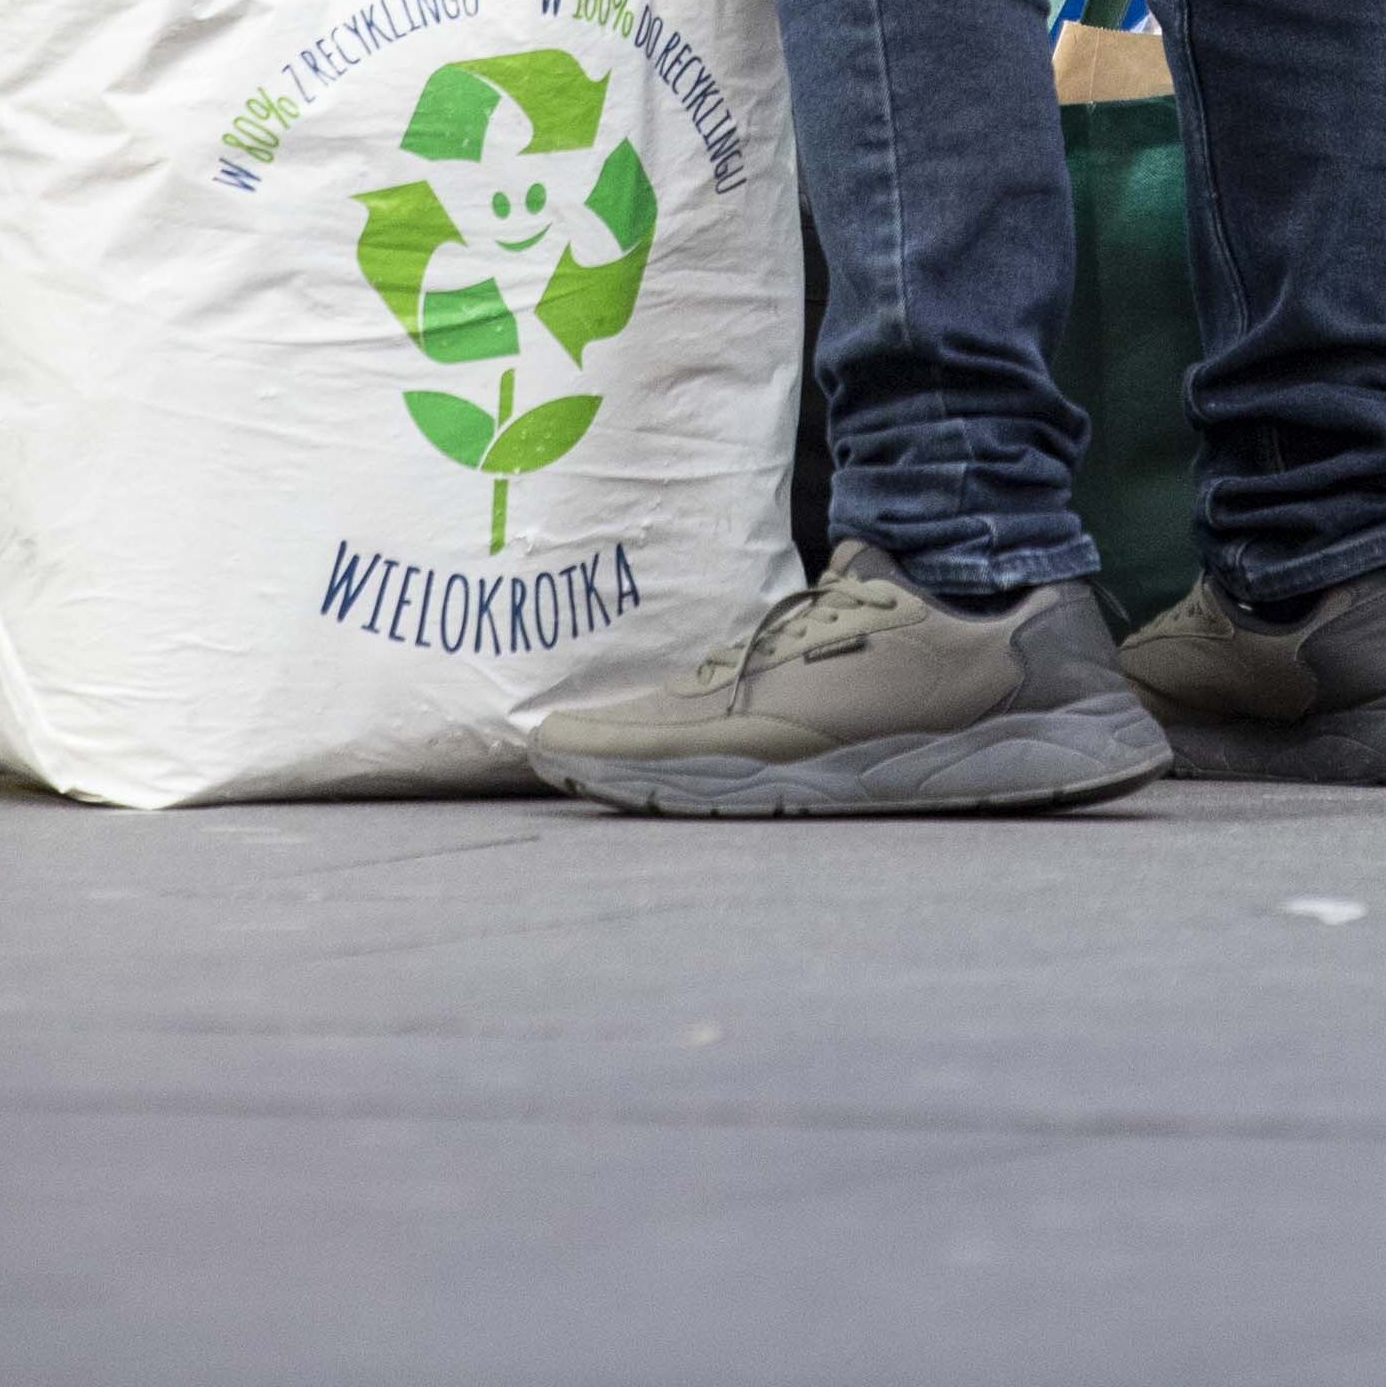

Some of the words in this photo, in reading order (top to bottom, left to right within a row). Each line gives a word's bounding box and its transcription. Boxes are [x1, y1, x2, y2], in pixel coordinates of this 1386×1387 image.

[281, 63, 316, 104] Z
[634, 4, 664, 59] DO
[655, 31, 748, 195] RECYKLINGU
[221, 86, 301, 164] 80%
[213, 157, 262, 192] W
[319, 539, 642, 657] WIELOKROTKA
